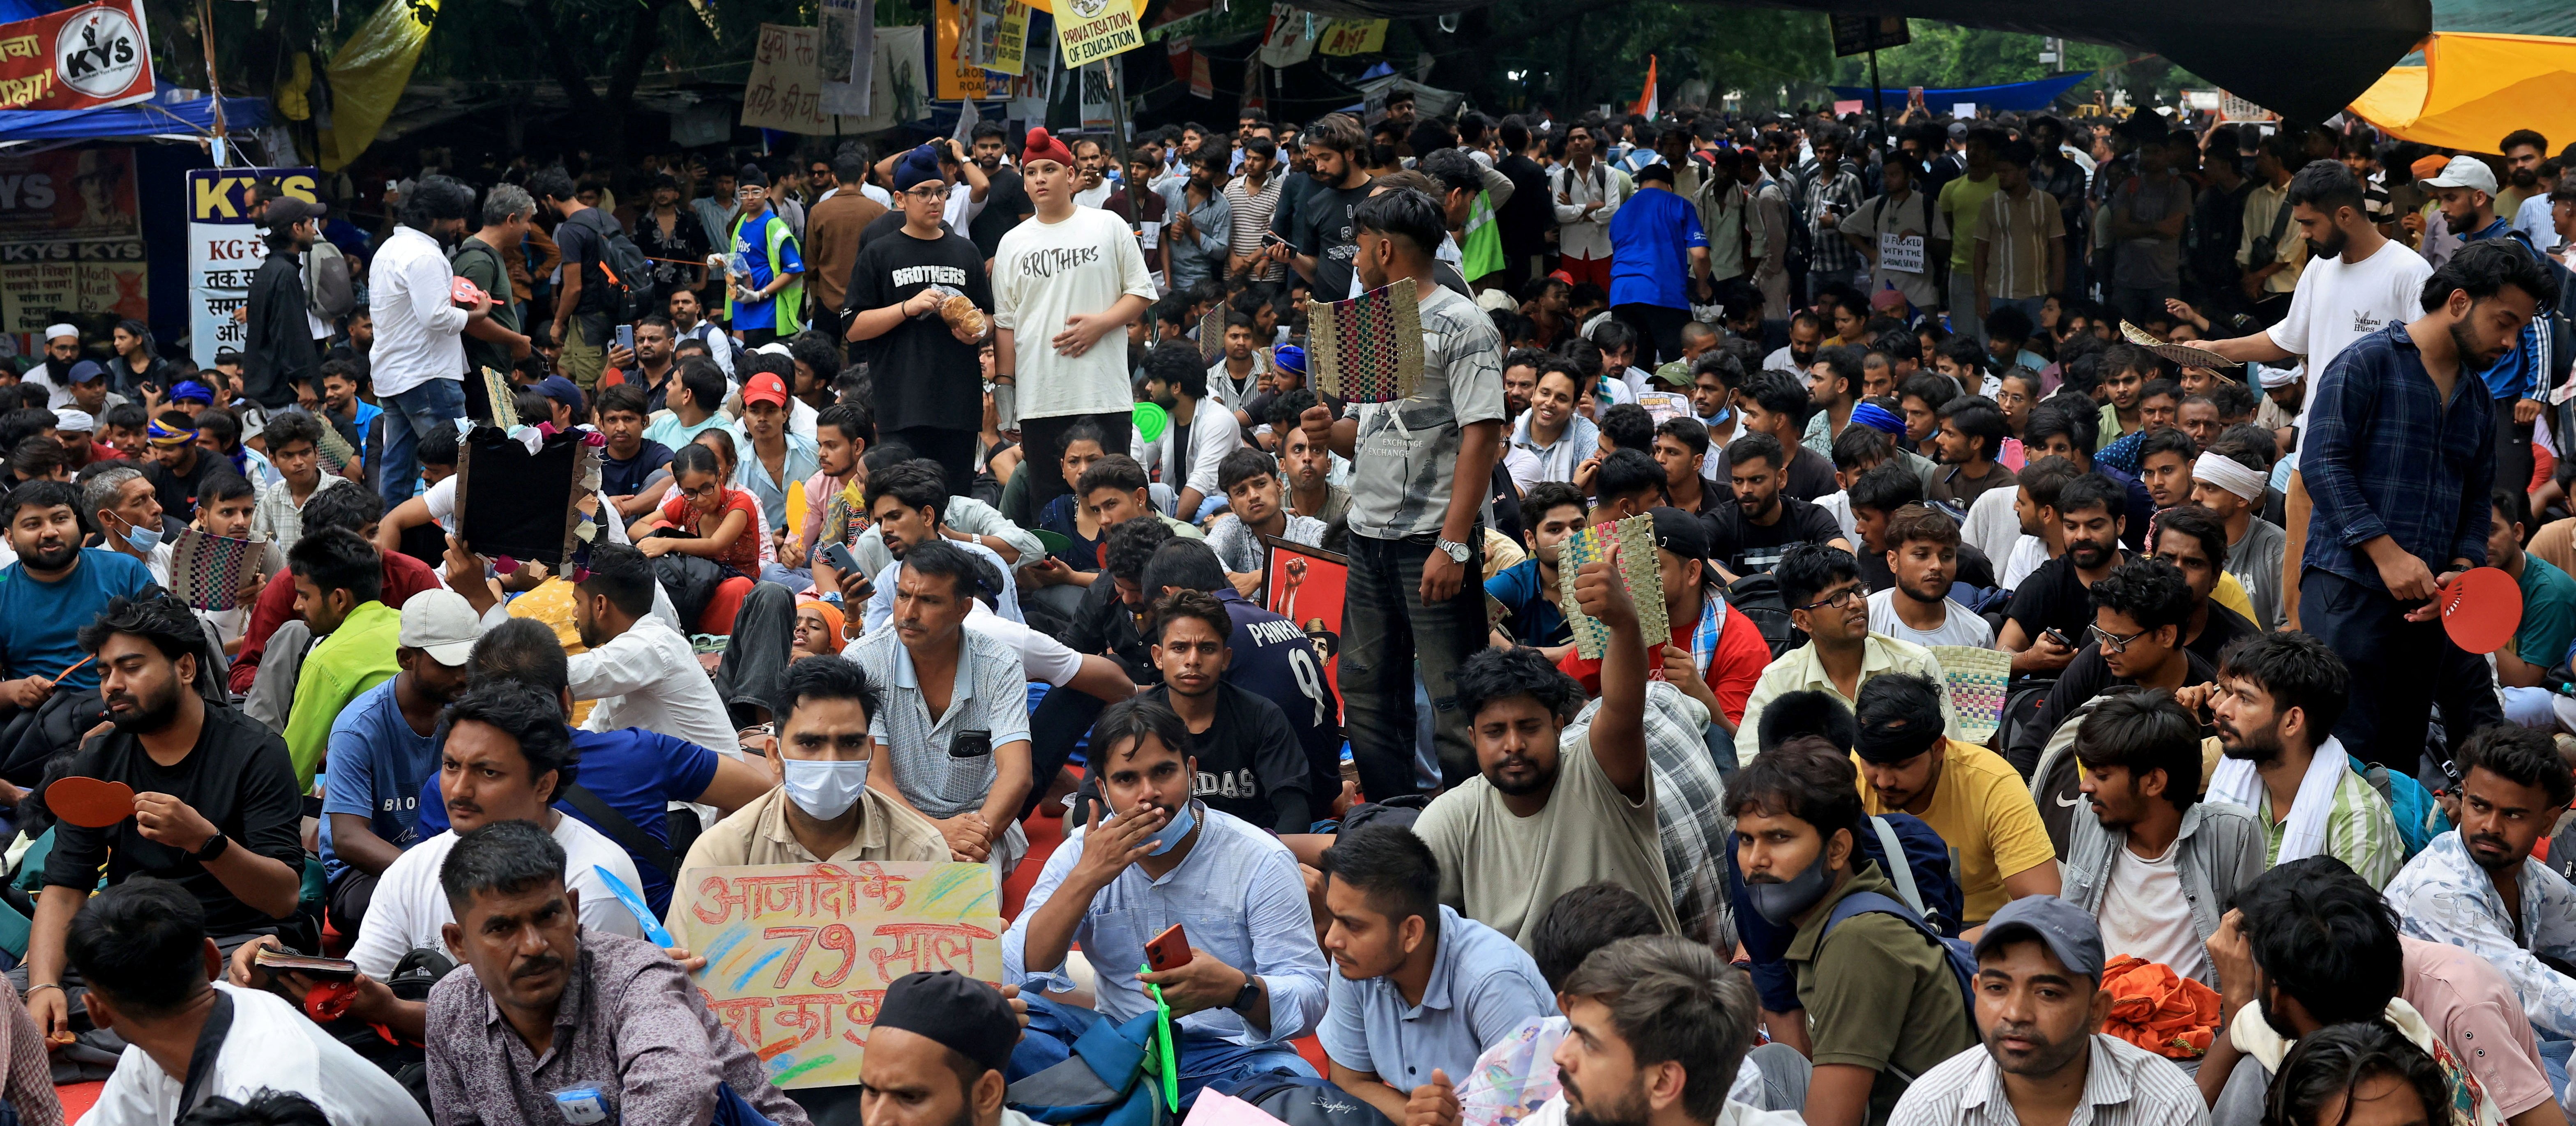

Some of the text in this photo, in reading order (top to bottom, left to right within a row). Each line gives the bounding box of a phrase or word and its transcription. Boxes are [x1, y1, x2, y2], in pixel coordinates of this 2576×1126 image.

[1063, 11, 1132, 46] PRIVATISATION
[0, 34, 41, 62] च्चा
[1069, 29, 1136, 62] OF EDUCATION
[67, 37, 134, 78] KYS
[956, 67, 984, 78] CROS
[960, 81, 985, 91] ROA
[196, 176, 316, 219] KS
[5, 243, 71, 261] KYS
[78, 242, 143, 259] KYS
[209, 240, 244, 260] KG
[1883, 246, 1903, 256] WITH
[1023, 246, 1099, 278] BROTHERS
[78, 267, 110, 281] Modi
[205, 269, 238, 288] तक
[892, 265, 965, 288] BROTHERS
[78, 281, 111, 296] Must
[78, 297, 98, 311] Go
[2354, 324, 2375, 332] Hues
[2355, 317, 2381, 325] Natural
[1640, 398, 1670, 406] STUDENTS
[1387, 438, 1423, 448] EXCHANGE
[1369, 447, 1410, 458] EXCHANGE
[1288, 648, 1325, 728] 9
[383, 797, 421, 811] BRO
[691, 861, 911, 925] आजादी के
[764, 924, 857, 989] 79
[774, 994, 847, 1043] का
